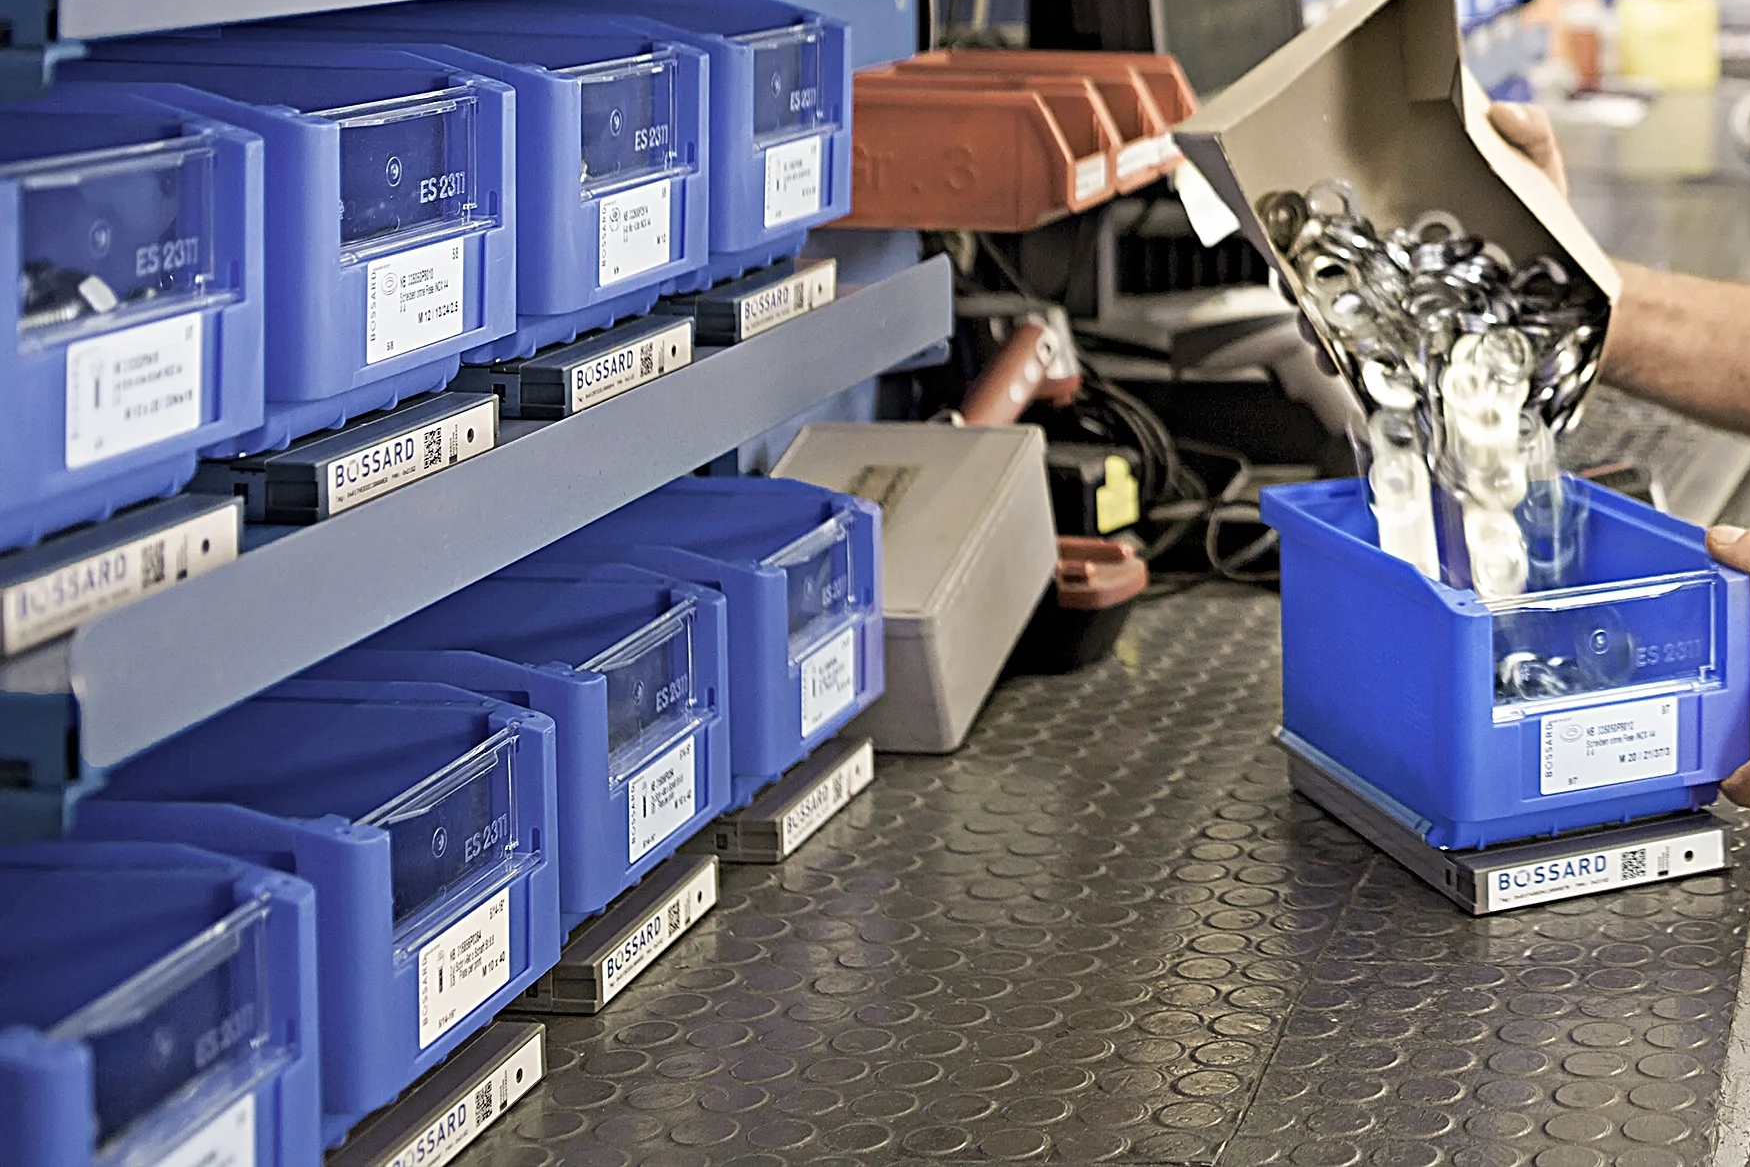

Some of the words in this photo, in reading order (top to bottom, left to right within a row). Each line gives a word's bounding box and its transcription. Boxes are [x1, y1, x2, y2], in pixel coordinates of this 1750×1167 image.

[634, 130, 648, 152] ES
[649, 124, 668, 147] 2311
[420, 177, 437, 203] ES
[439, 171, 466, 199] 2311
[135, 243, 160, 277] ES
[745, 286, 788, 319] BOSSARD
[577, 350, 633, 390] BOSSARD
[335, 437, 414, 488] BOSSARD
[1636, 645, 1660, 667] ES
[1662, 638, 1701, 663] 2311
[656, 687, 670, 713] ES
[1545, 723, 1554, 778] BOSSARD
[787, 783, 828, 833] BOSSARD
[465, 832, 481, 863] ES
[482, 813, 508, 852] 2311
[1498, 855, 1607, 891] BOSSARD
[607, 915, 661, 979] BOSSARD
